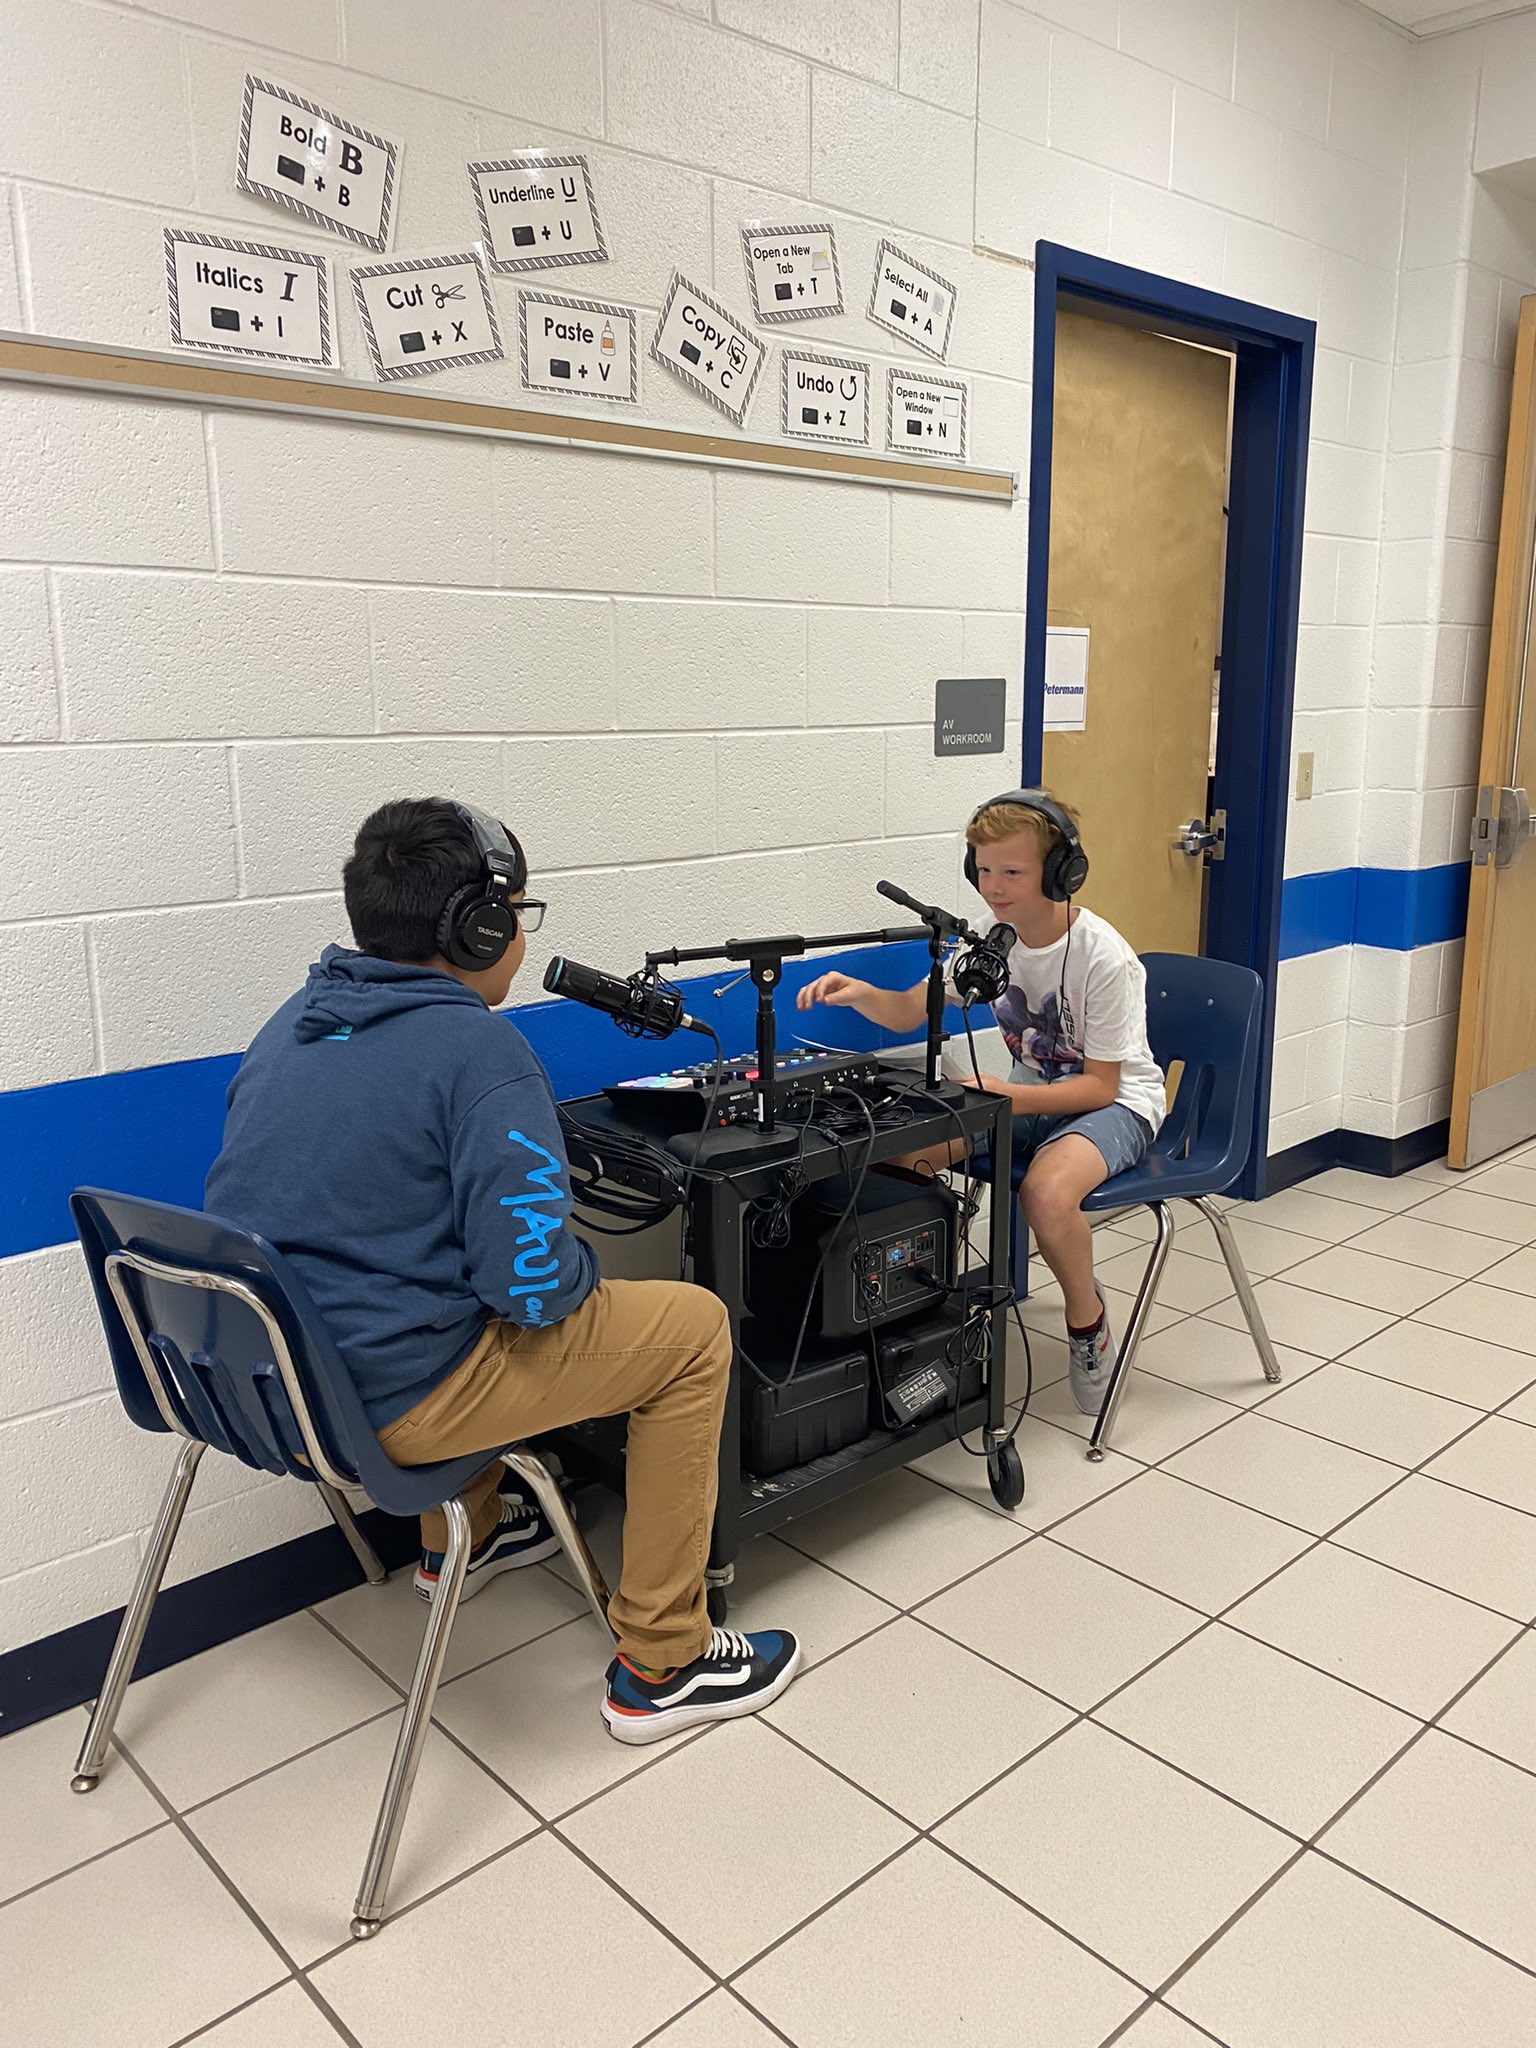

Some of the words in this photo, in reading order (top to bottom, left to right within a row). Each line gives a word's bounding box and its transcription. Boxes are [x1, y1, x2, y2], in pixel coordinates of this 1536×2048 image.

[280, 115, 327, 156] Bold
[339, 140, 363, 176] B
[314, 176, 326, 192] +
[338, 184, 351, 207] B
[489, 185, 554, 204] Underline
[561, 177, 577, 202] U
[542, 226, 551, 240] +
[560, 220, 572, 240] U
[753, 248, 780, 261] Open
[783, 248, 789, 256] a
[791, 245, 810, 256] New
[776, 262, 794, 274] Tab
[197, 262, 263, 293] Italics
[280, 272, 298, 301] I
[797, 283, 804, 295] +
[811, 278, 817, 294] T
[884, 268, 914, 293] Select
[915, 286, 929, 303] All
[387, 284, 423, 309] Cut
[251, 316, 263, 332] +
[278, 316, 282, 337] I
[432, 330, 442, 345] +
[451, 321, 467, 342] X
[545, 317, 593, 343] Paste
[682, 305, 726, 350] Copy
[911, 313, 918, 324] +
[924, 319, 932, 335] A
[578, 365, 587, 378] +
[599, 363, 610, 381] V
[706, 361, 713, 372] +
[721, 371, 732, 388] C
[798, 372, 833, 393] Undo
[896, 387, 918, 401] Open
[920, 392, 925, 400] a
[927, 392, 941, 402] New
[825, 412, 831, 424] +
[840, 410, 846, 426] Z
[905, 401, 933, 414] Window
[927, 424, 932, 435] +
[939, 422, 946, 437] N
[942, 719, 954, 729] AV
[942, 733, 992, 745] WORKROOM
[477, 926, 504, 938] TASCAM
[499, 1129, 565, 1297] MAUI
